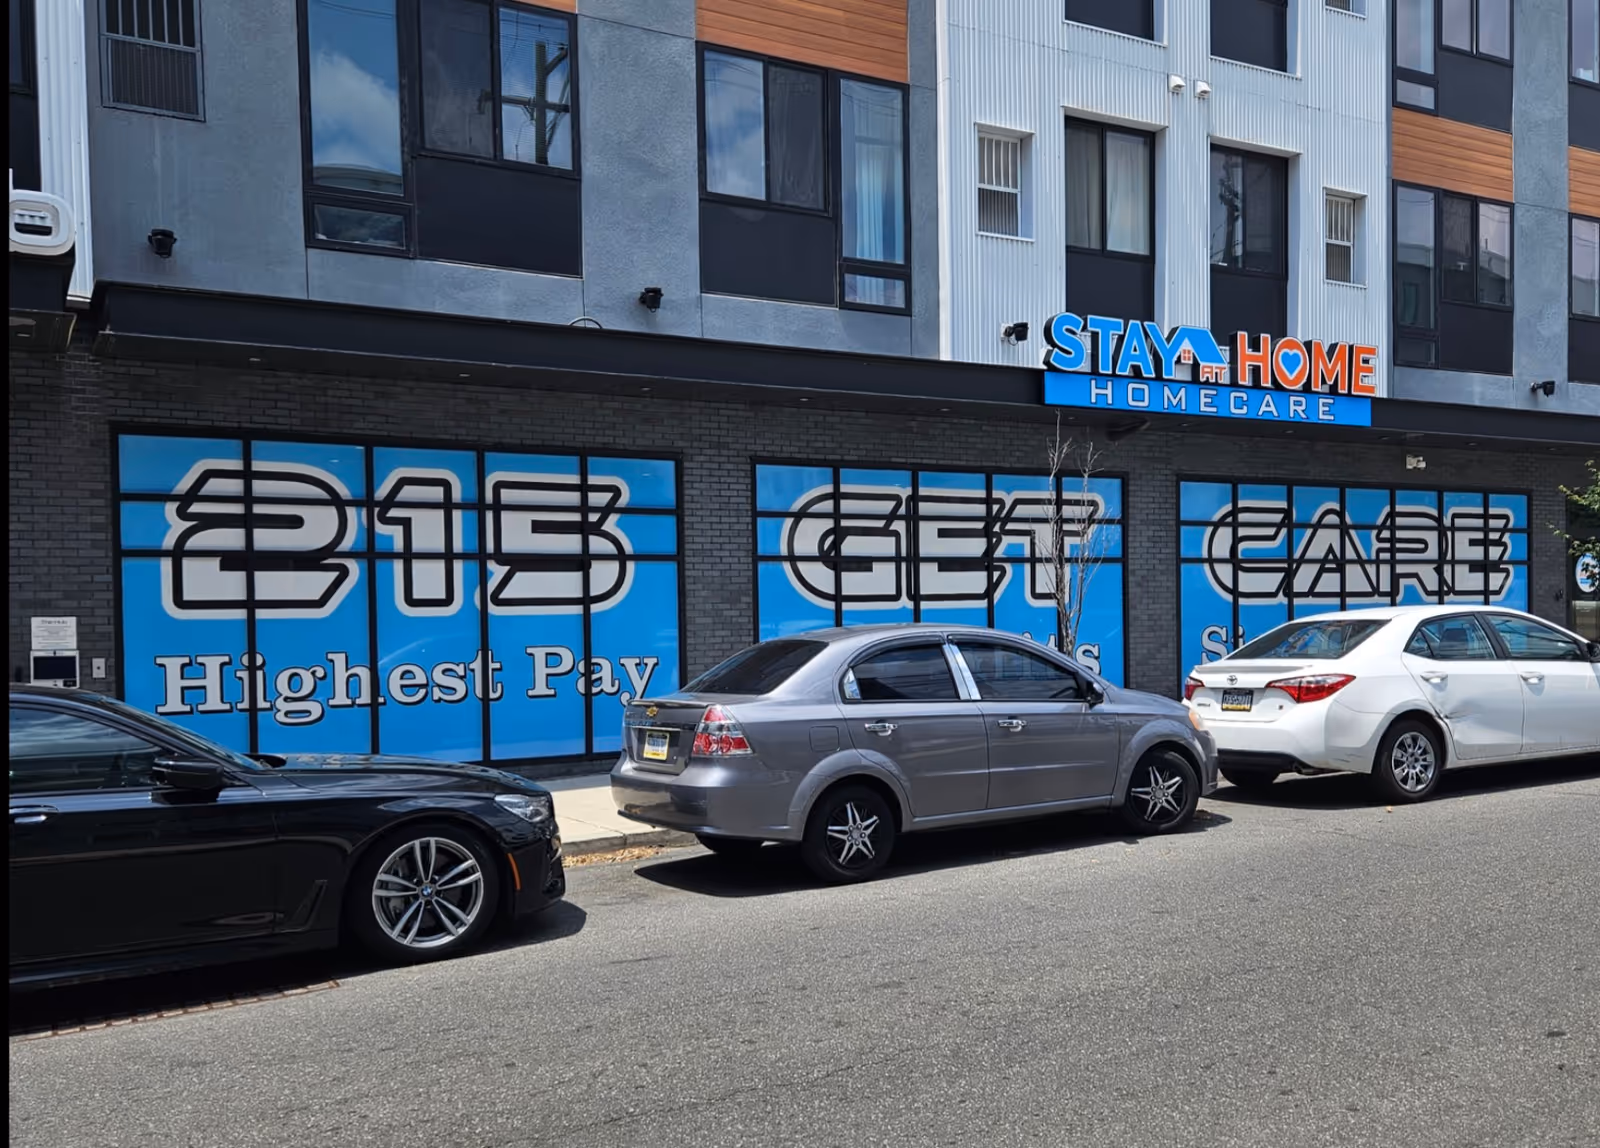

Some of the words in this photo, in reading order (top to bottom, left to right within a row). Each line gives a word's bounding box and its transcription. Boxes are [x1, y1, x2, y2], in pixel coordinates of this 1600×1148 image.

[1049, 311, 1181, 379] STAY
[1201, 364, 1228, 383] AT
[1237, 331, 1378, 396] HOME
[1089, 378, 1336, 421] HOMECARE
[160, 458, 635, 620] 215
[780, 483, 1106, 611] GET
[1202, 500, 1515, 604] CARE
[154, 648, 504, 726] Highest
[526, 644, 660, 706] Pay
